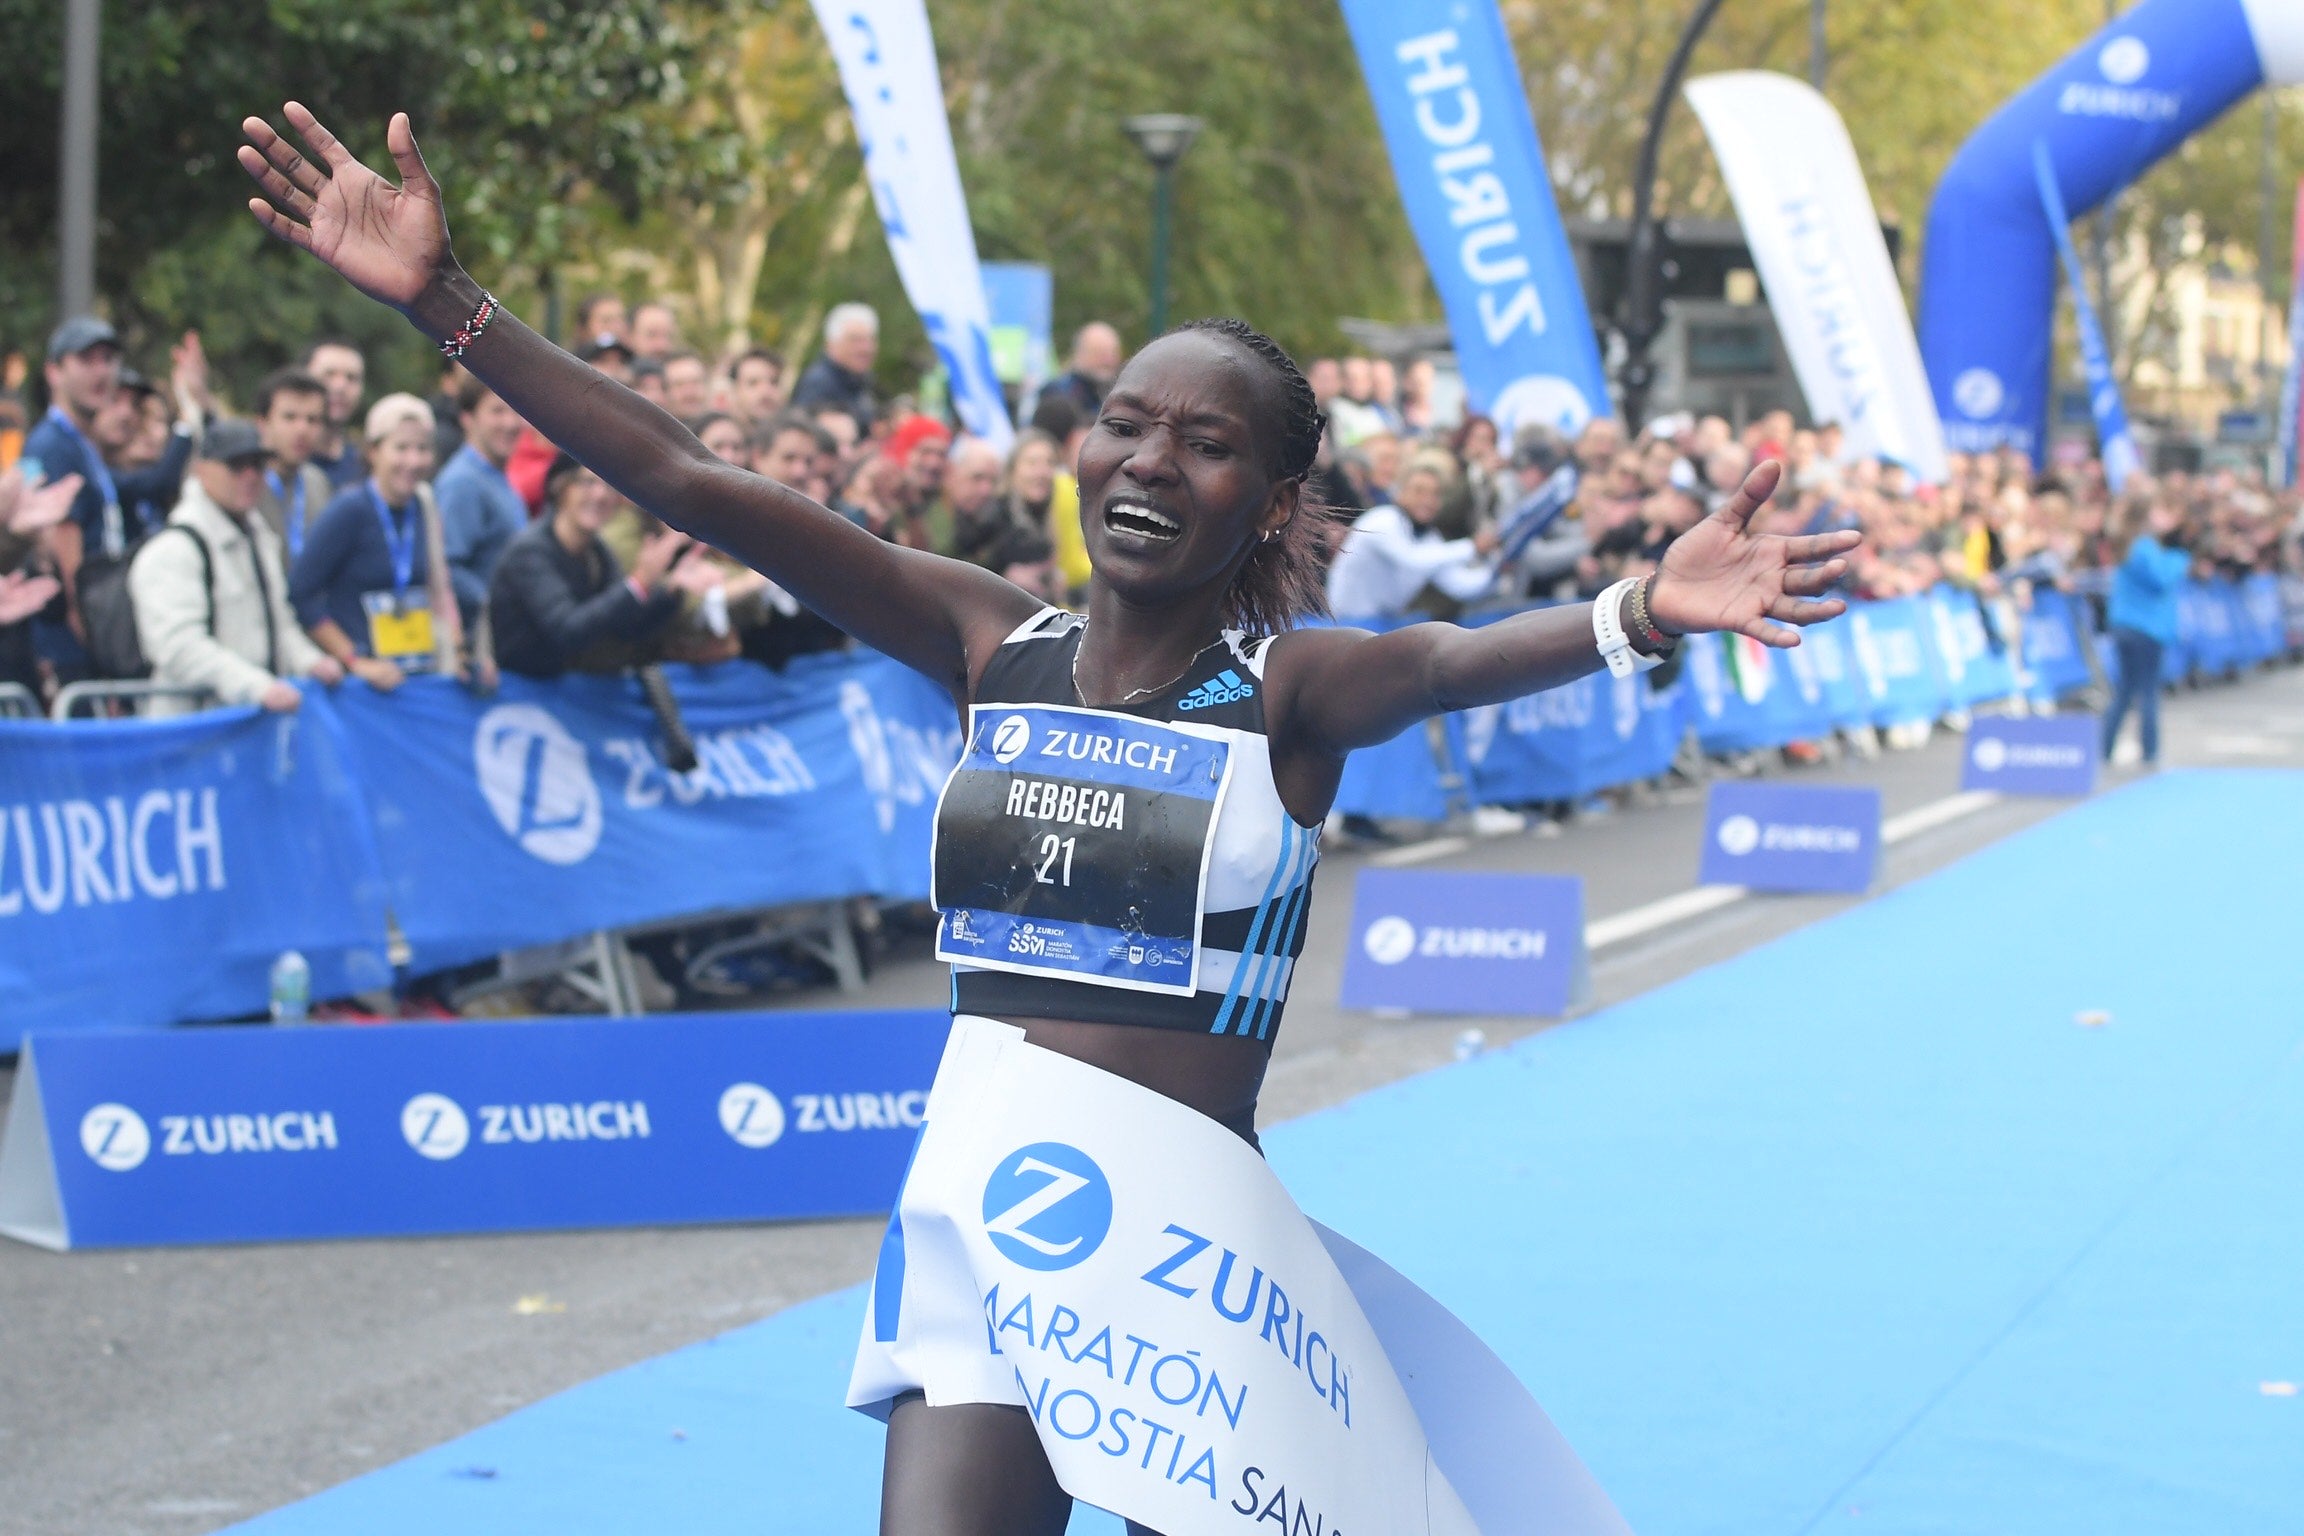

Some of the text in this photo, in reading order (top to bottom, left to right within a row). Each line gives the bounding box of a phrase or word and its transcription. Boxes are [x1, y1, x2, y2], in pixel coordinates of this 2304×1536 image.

[2057, 82, 2181, 121] ZURICH
[1178, 682, 1253, 711] adidas
[1040, 729, 1177, 774] ZURICH
[1005, 778, 1125, 831] REBBECA
[1760, 822, 1860, 852] ZURICH
[1037, 833, 1076, 887] 21
[1036, 926, 1065, 937] ZURICH
[1420, 927, 1547, 959] ZURICH
[159, 1110, 339, 1155] ZURICH
[479, 1100, 651, 1144] ZURICH
[1140, 1223, 1351, 1430] ZURICH
